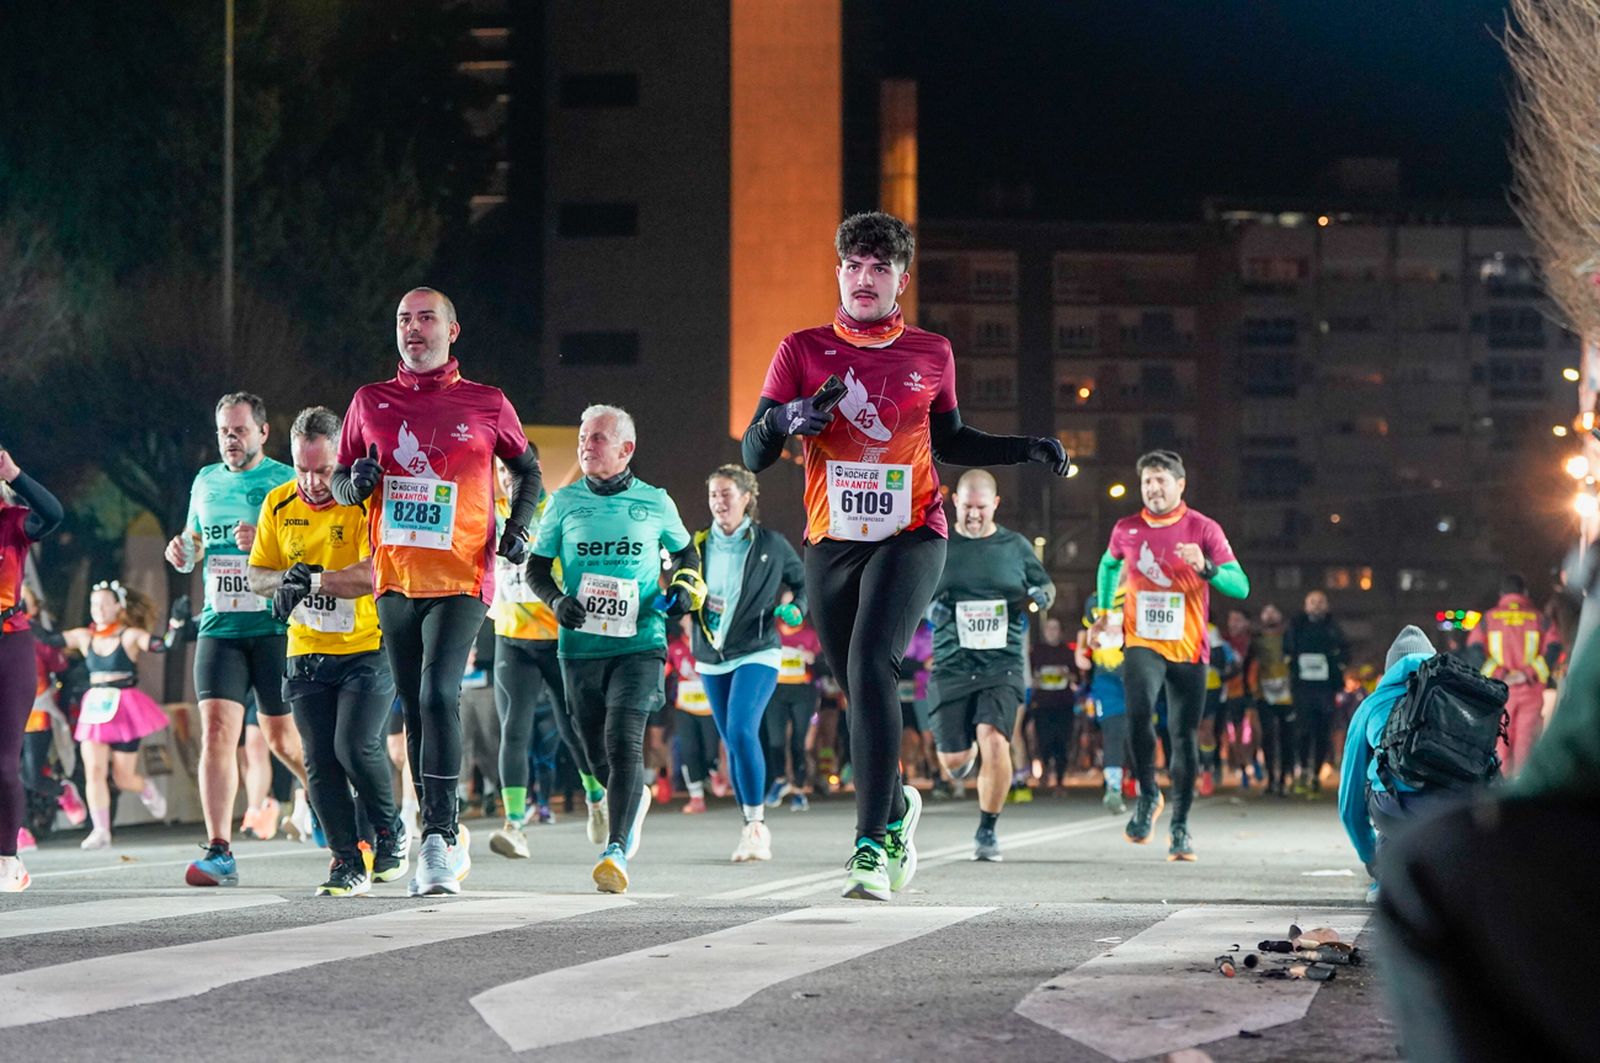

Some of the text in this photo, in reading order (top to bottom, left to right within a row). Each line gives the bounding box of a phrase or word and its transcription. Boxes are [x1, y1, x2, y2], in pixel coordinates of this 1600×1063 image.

[854, 408, 876, 429] 43
[407, 456, 428, 474] 43
[835, 479, 849, 488] SAN
[850, 480, 879, 490] ANTÓN
[844, 470, 879, 480] NOCHE DE
[391, 491, 404, 500] SAN
[841, 489, 893, 515] 6109
[393, 501, 442, 525] 8283
[204, 519, 240, 540] ser
[576, 536, 643, 557] serás
[586, 596, 628, 617] 6239
[968, 618, 1000, 632] 3078
[1145, 609, 1174, 624] 1996
